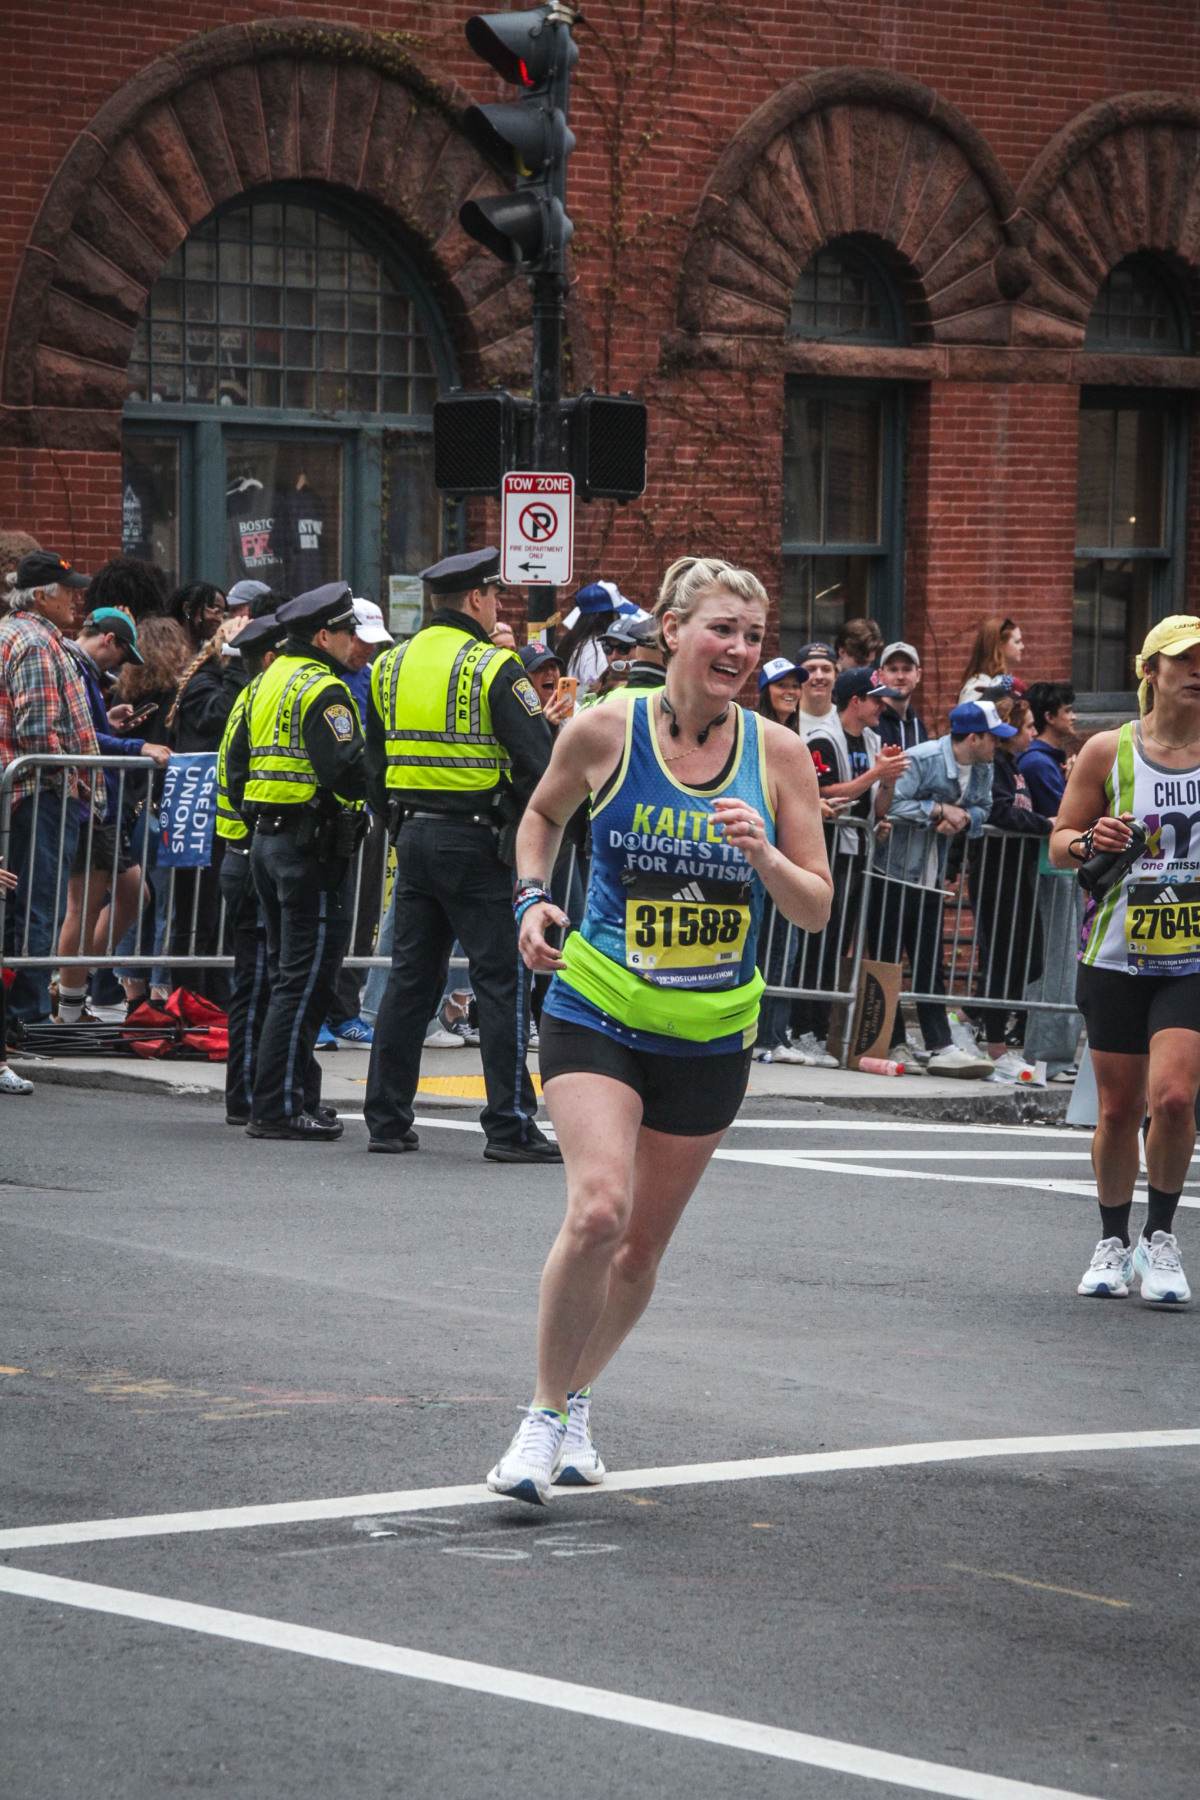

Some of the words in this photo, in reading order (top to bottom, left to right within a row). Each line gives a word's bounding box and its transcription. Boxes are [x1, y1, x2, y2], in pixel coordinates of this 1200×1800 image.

[508, 478, 533, 490] TOW
[536, 478, 569, 491] ZONE
[281, 667, 320, 733] POLICE
[458, 646, 482, 720] POLICE
[161, 765, 181, 808] KIDS
[1154, 780, 1200, 807] CHLO
[172, 766, 201, 853] UNIONS
[190, 766, 216, 853] CREDIT
[632, 803, 732, 844] KAITL
[627, 853, 667, 873] FOR
[674, 859, 753, 882] AUTISM
[719, 844, 747, 863] TE
[1141, 862, 1164, 871] one
[635, 905, 742, 948] 31588
[1131, 906, 1200, 940] 27645
[632, 954, 640, 963] 6
[671, 974, 697, 983] BOSTON
[698, 970, 734, 980] MARATHON
